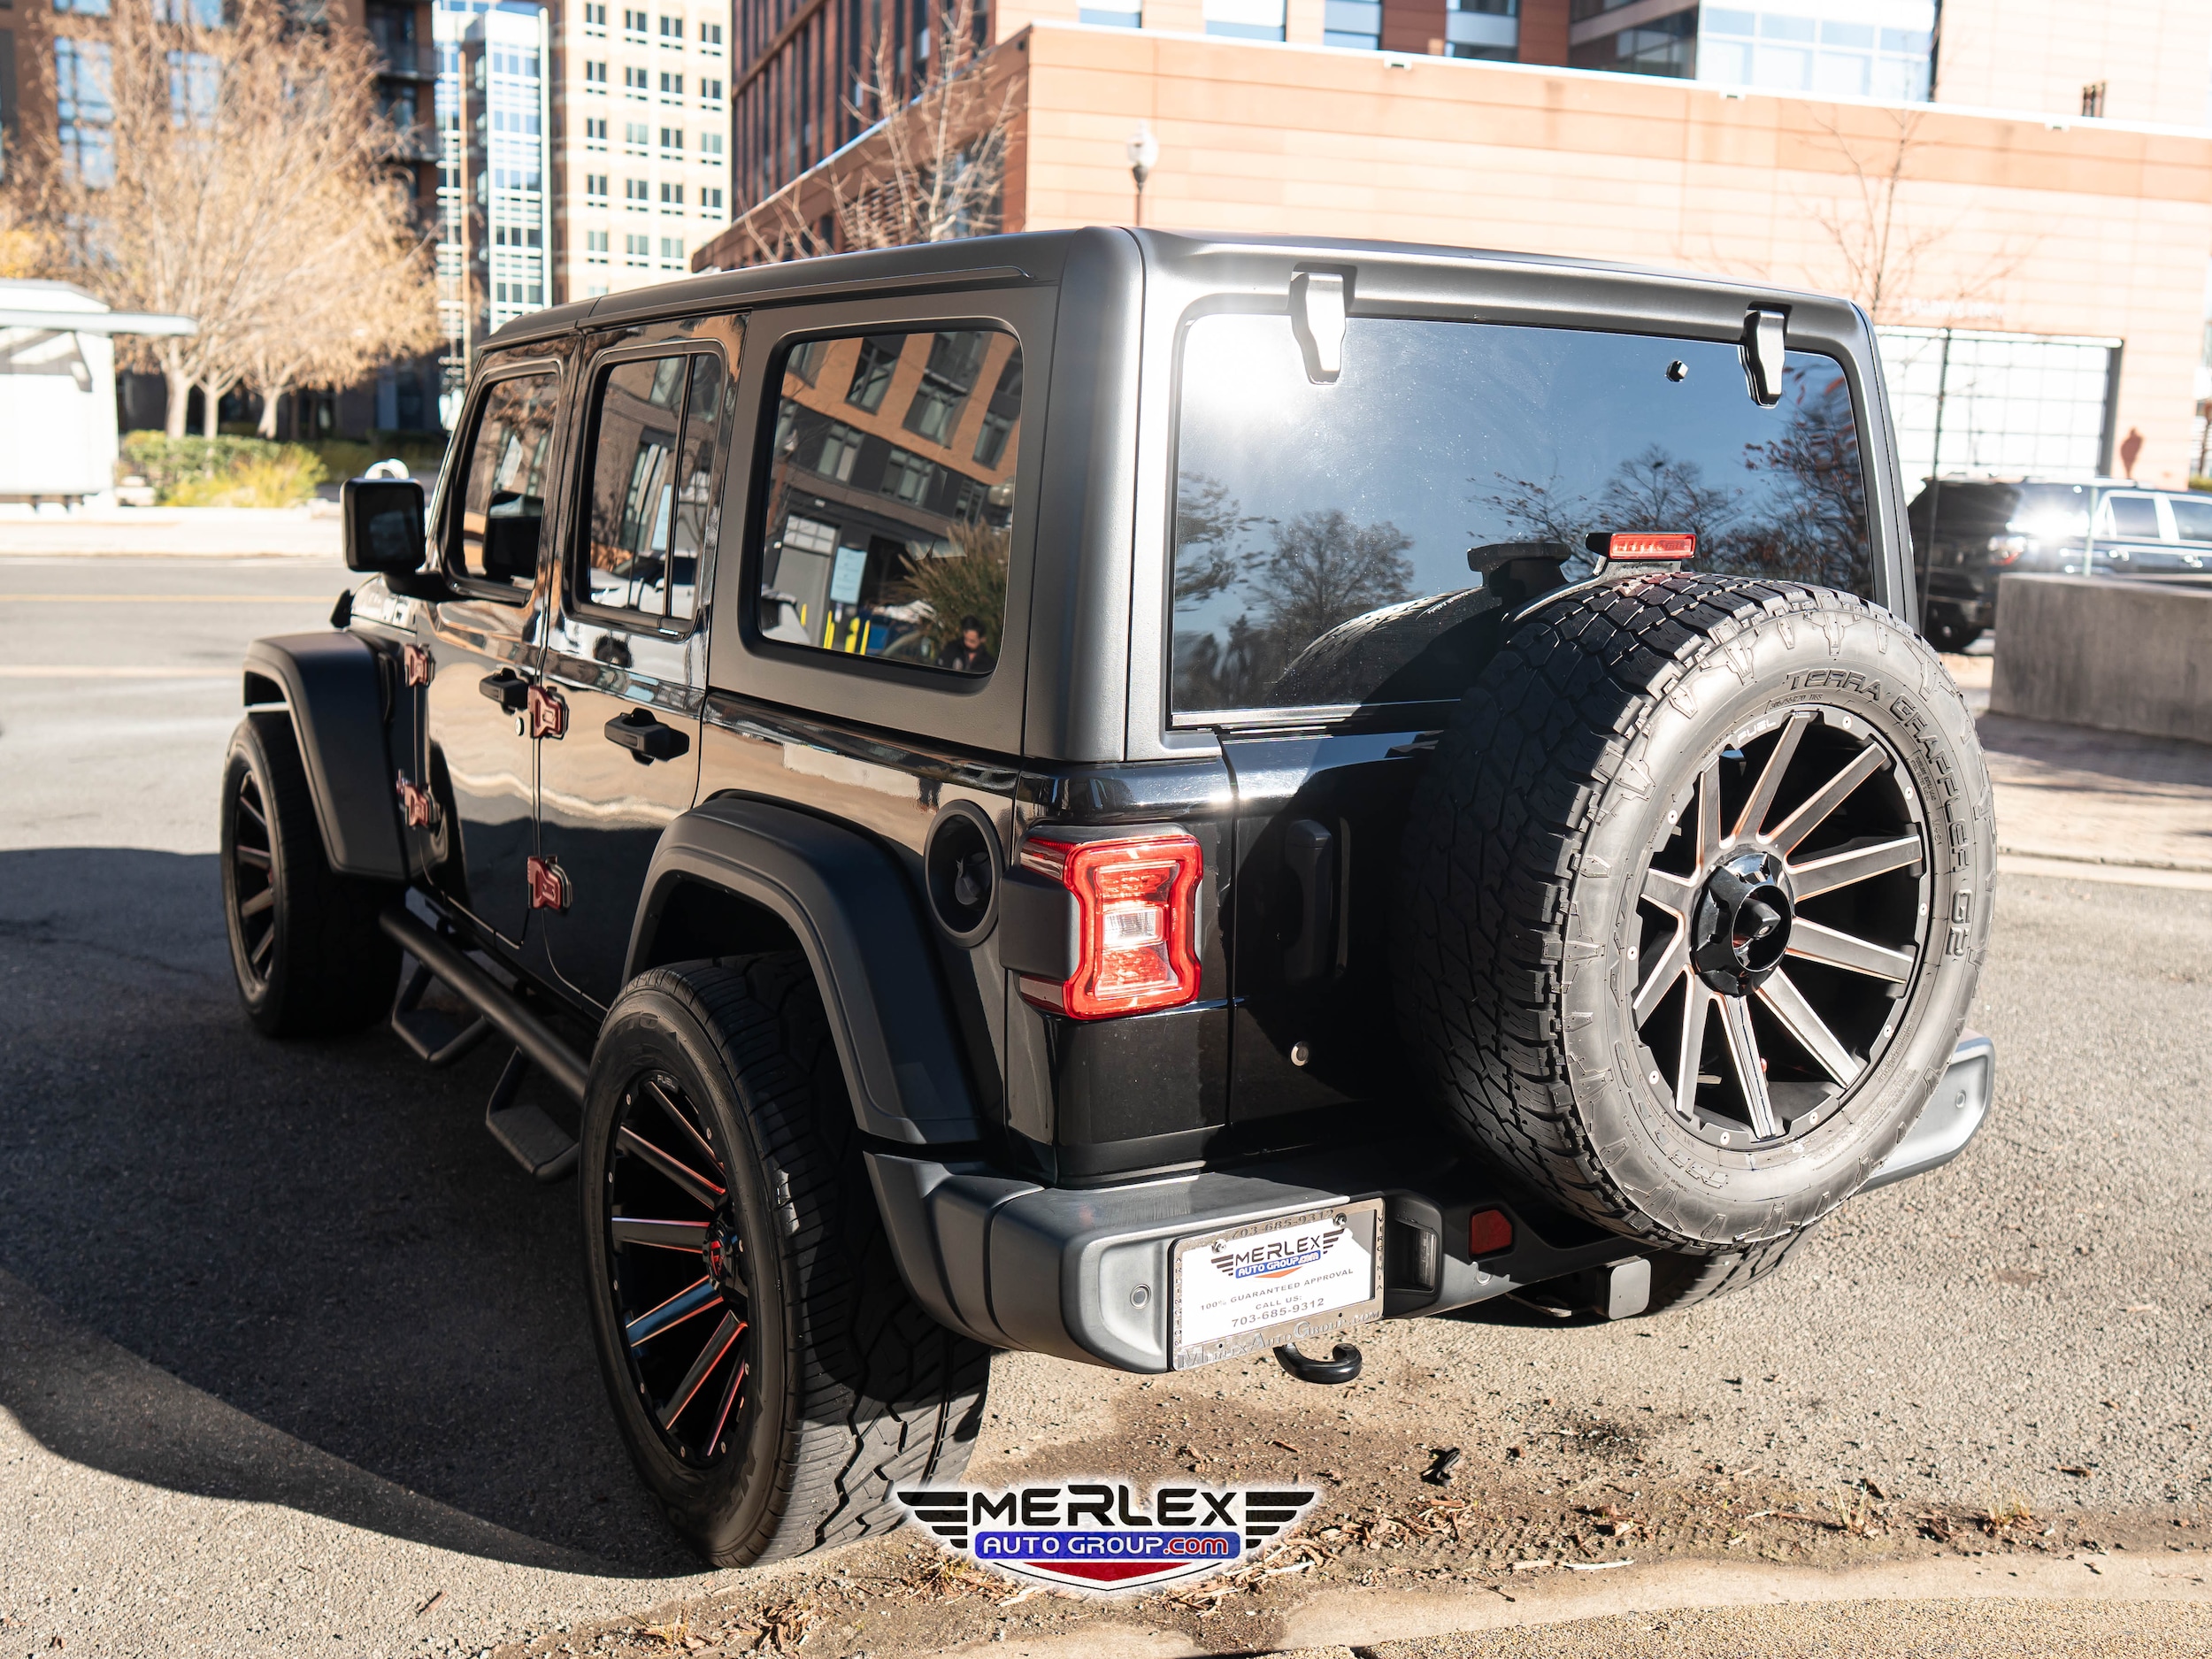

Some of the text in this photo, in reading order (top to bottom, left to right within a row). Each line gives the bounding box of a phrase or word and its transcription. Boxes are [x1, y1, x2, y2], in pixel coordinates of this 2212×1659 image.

[1737, 718, 1777, 744] FUEL
[1786, 668, 1971, 956] TERRA GRAPPLER G2
[657, 1074, 676, 1089] FUEL
[1235, 1235, 1320, 1267] MERLEX
[1239, 1263, 1264, 1277] AUTO
[1201, 1269, 1354, 1311] 100% GUARANTEED APPROVAL
[1256, 1295, 1302, 1310] CALL US:
[1232, 1297, 1325, 1328] 703-685-9312
